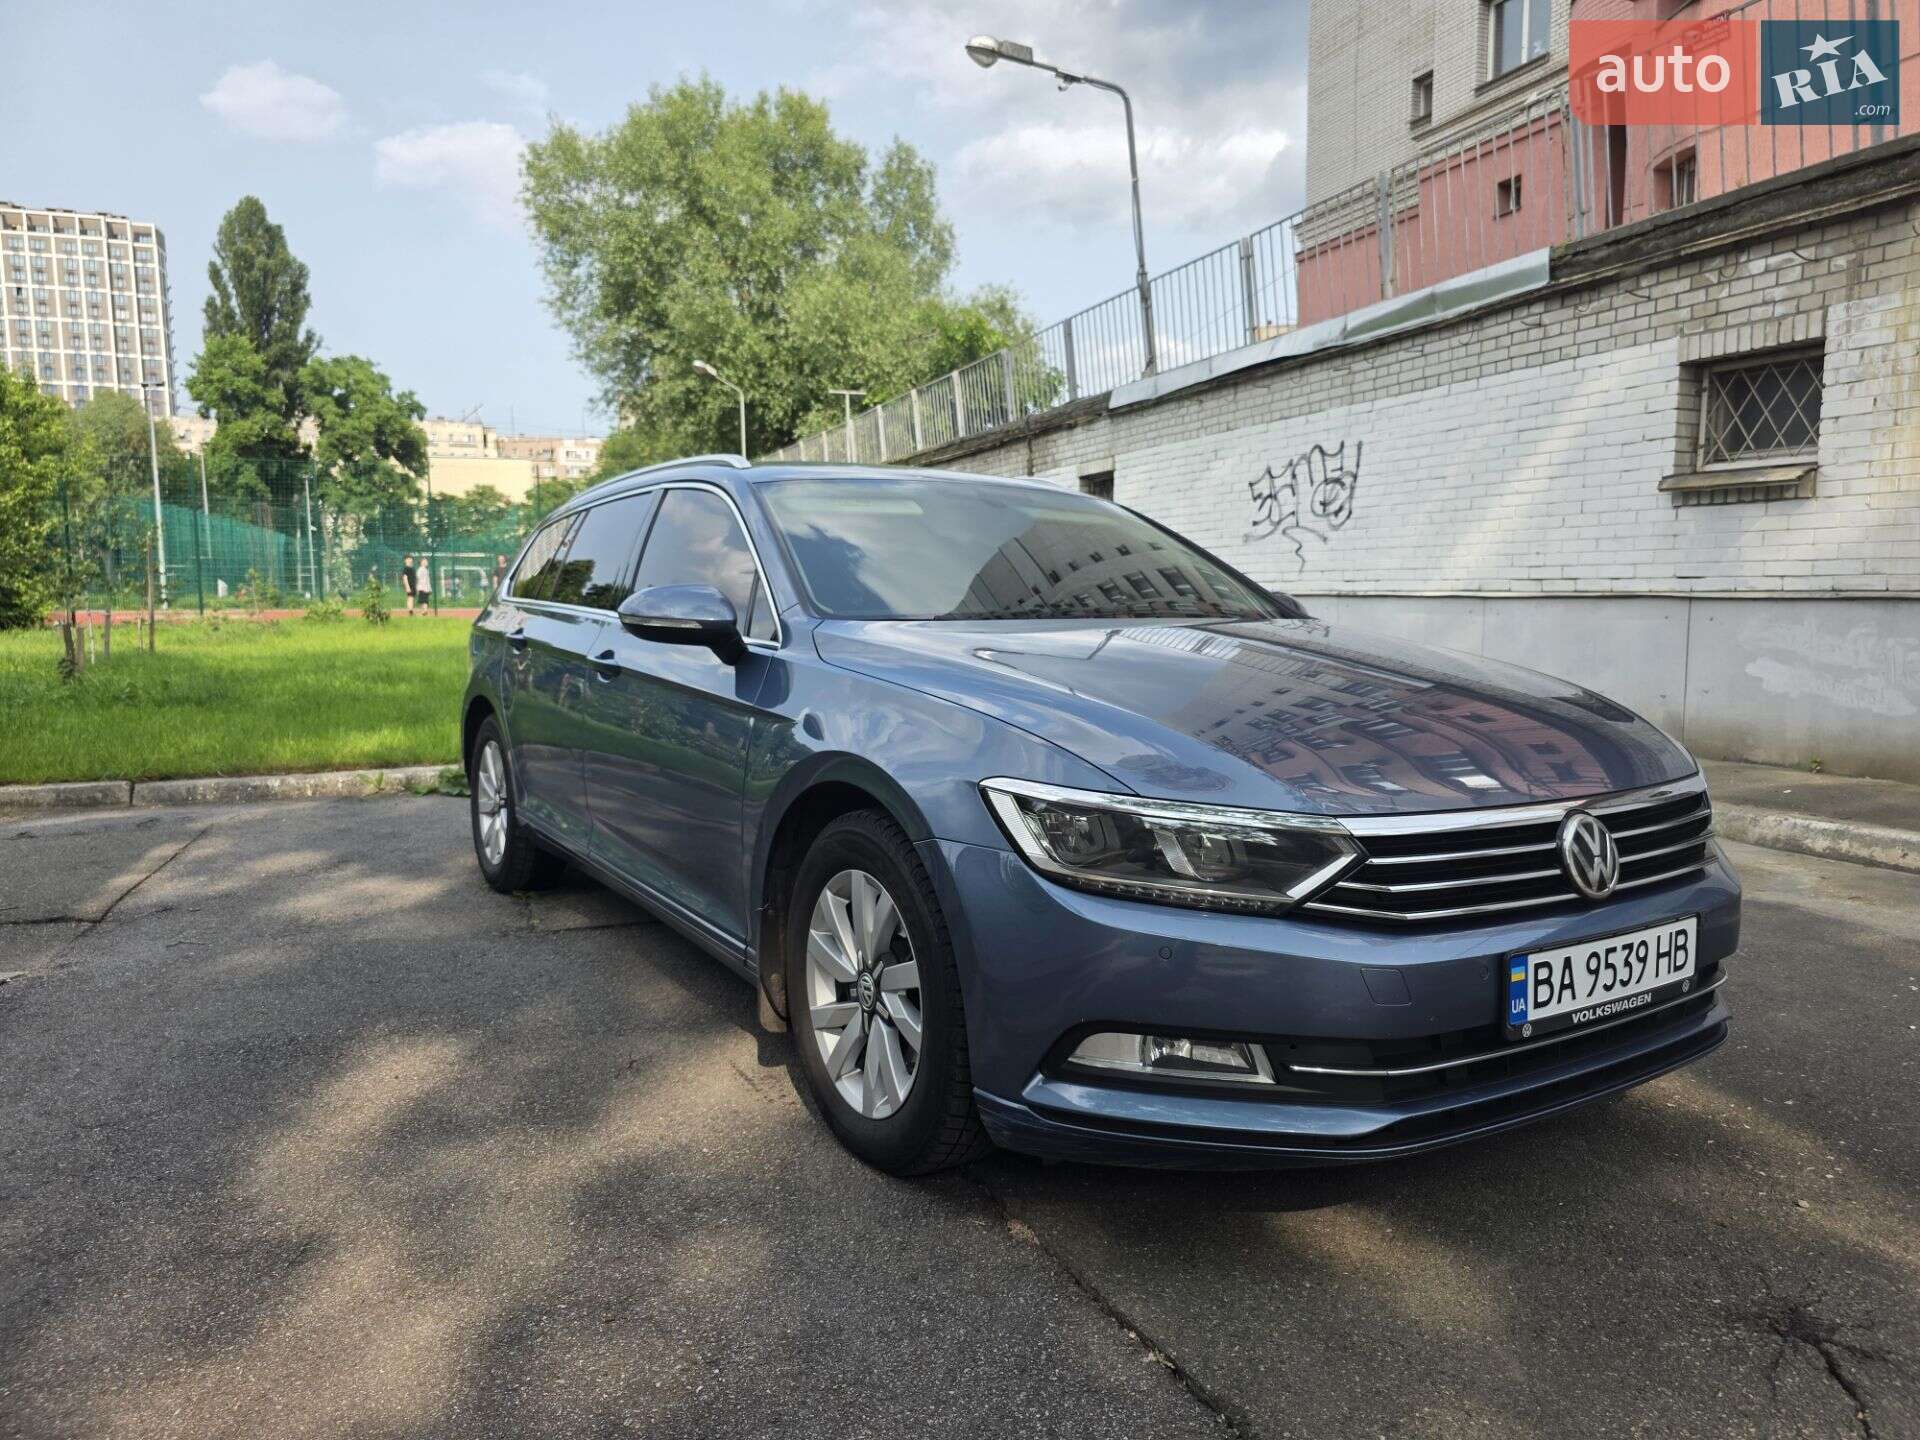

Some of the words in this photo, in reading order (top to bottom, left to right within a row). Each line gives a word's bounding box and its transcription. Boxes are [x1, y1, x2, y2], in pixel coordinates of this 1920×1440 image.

[1533, 956, 1576, 1010] BA
[1586, 940, 1649, 998] 9539
[1655, 928, 1689, 978] HB
[1511, 1000, 1526, 1014] UA
[1571, 992, 1652, 1024] VOLKSWAGEN
